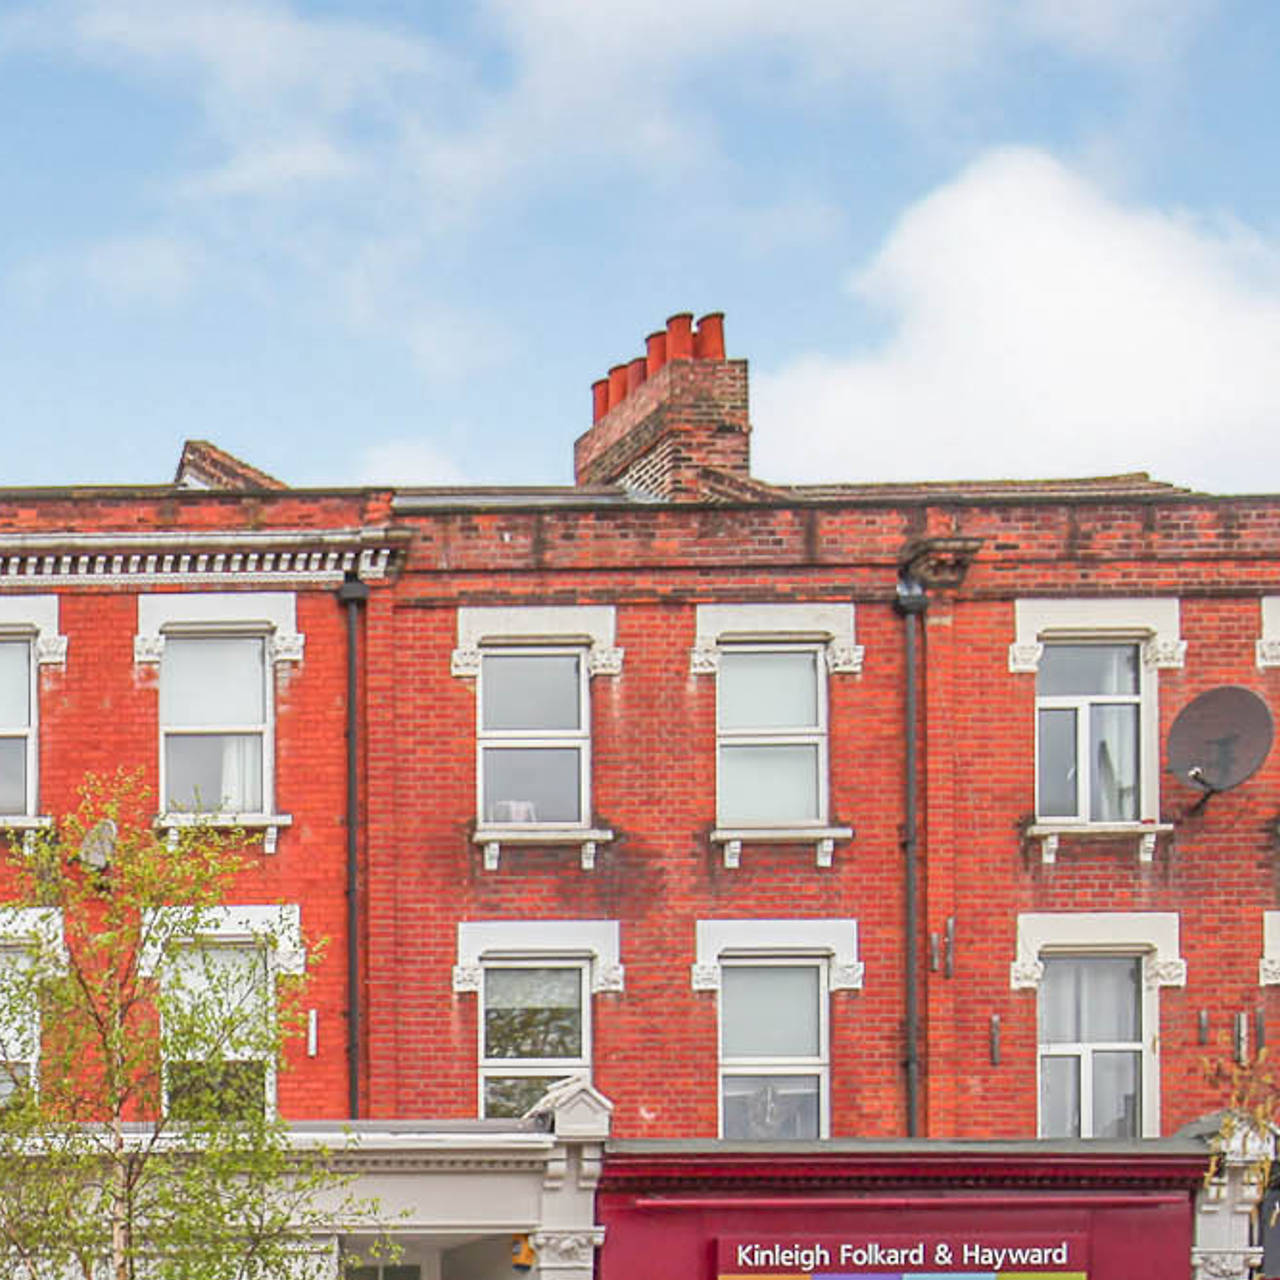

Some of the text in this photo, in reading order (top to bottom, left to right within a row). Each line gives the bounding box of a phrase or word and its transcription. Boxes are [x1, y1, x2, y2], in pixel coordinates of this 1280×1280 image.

[737, 1242, 1068, 1271] Kinleigh Folkard & Hayward
